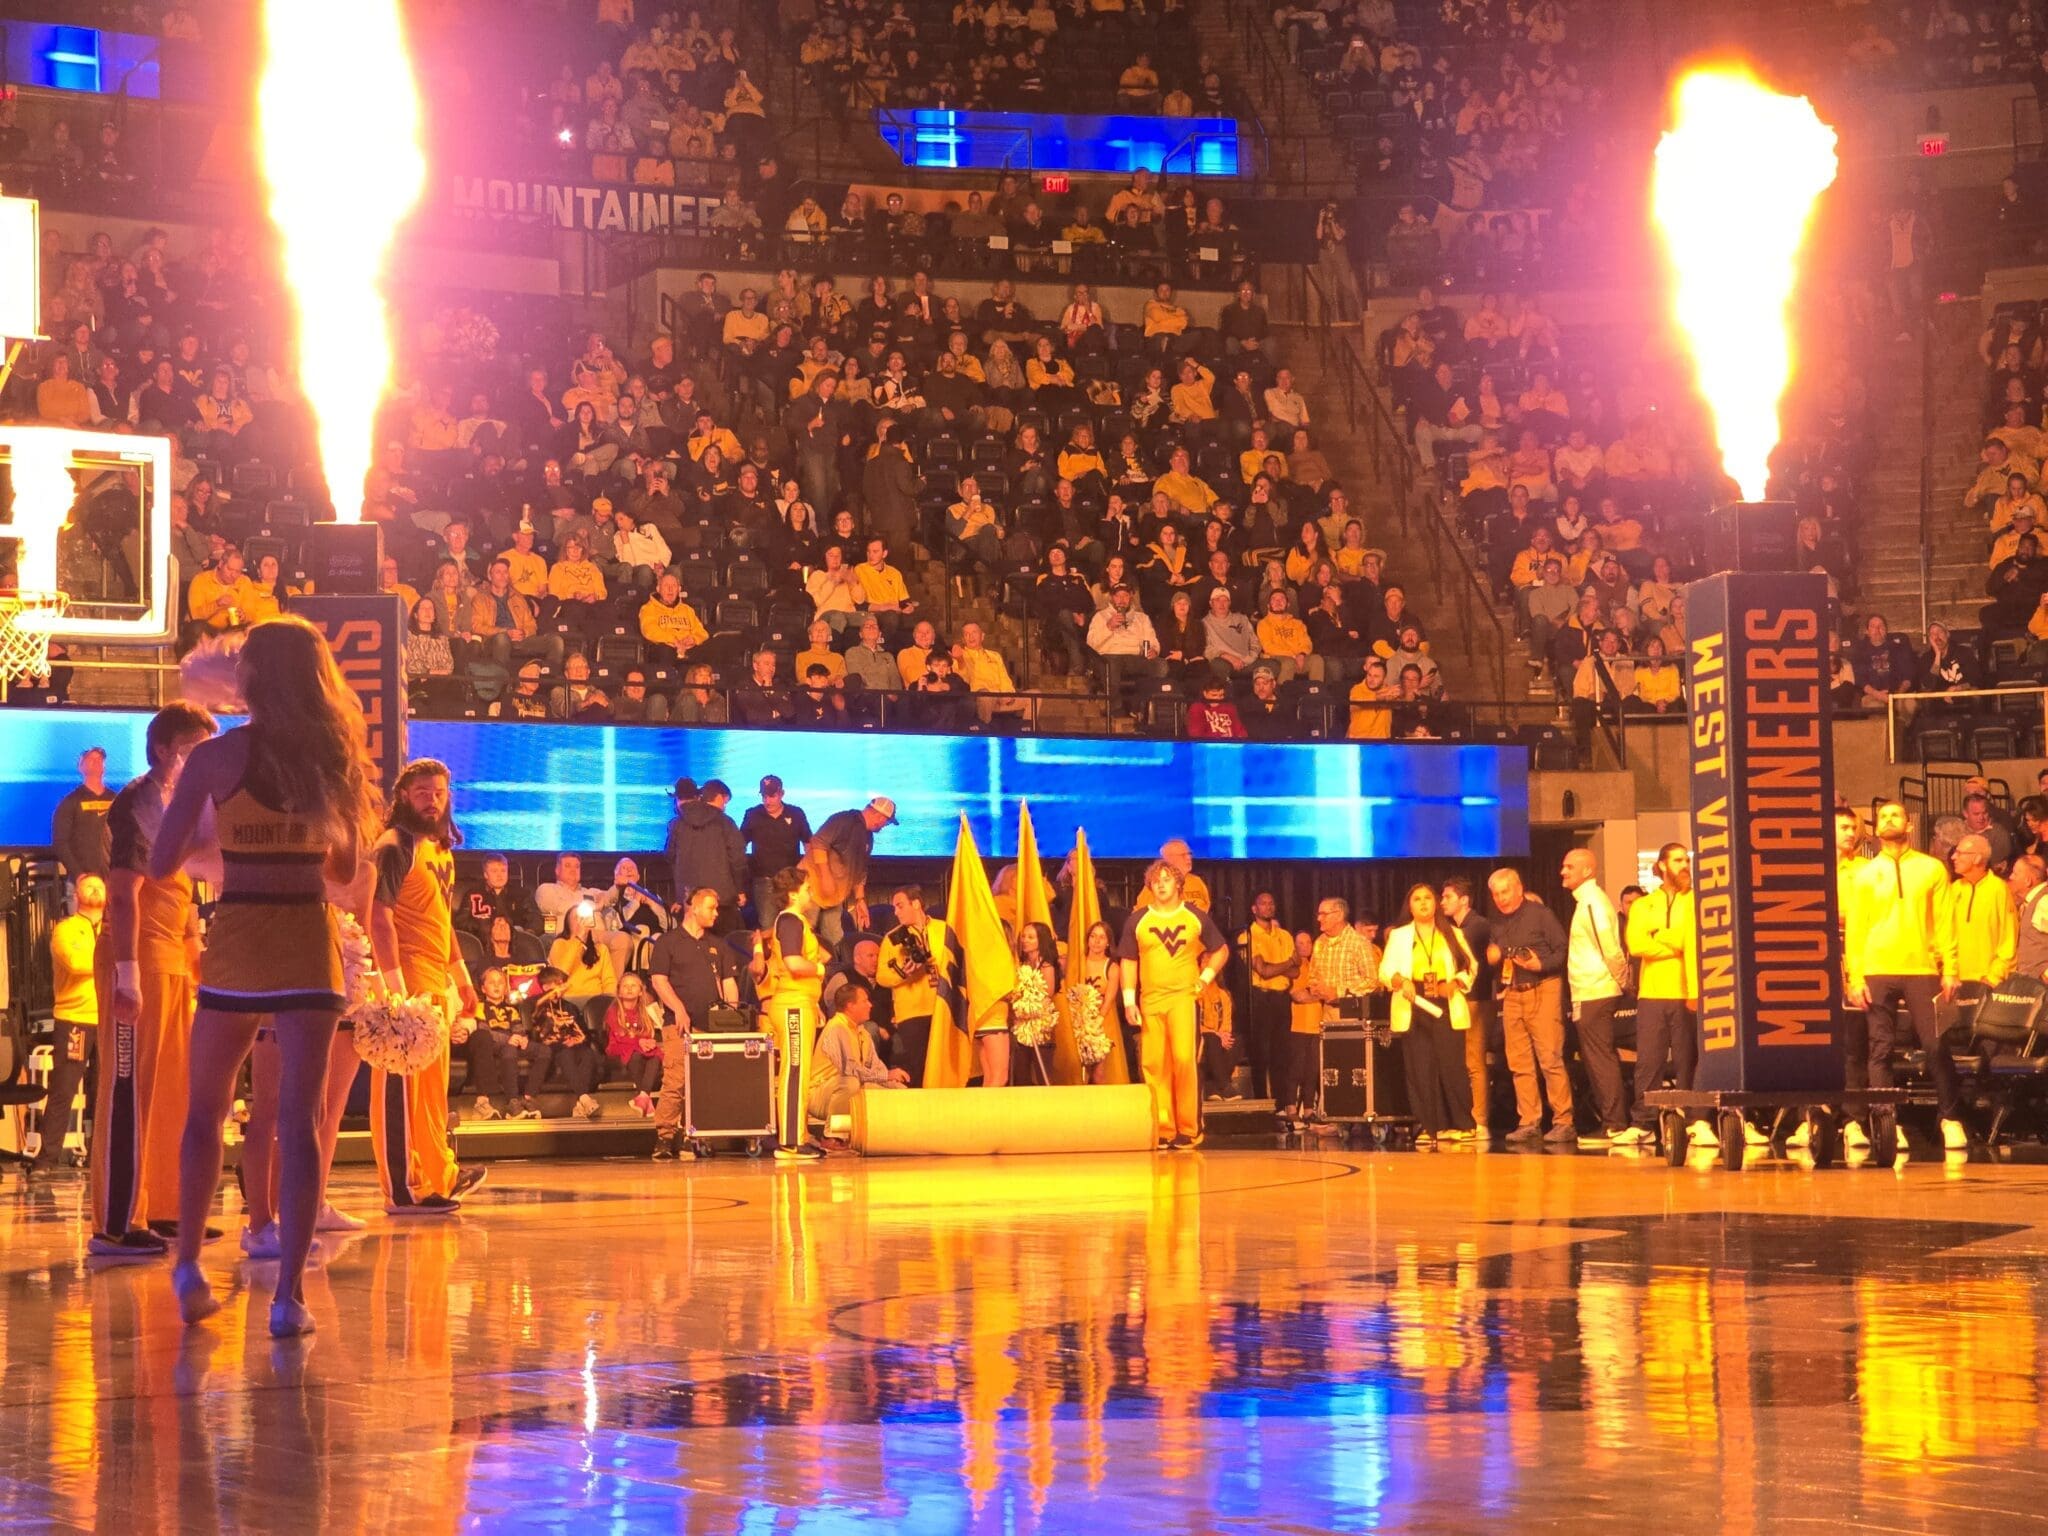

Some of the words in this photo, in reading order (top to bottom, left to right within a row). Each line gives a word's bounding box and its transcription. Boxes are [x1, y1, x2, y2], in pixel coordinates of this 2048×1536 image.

[1046, 177, 1065, 192] EXIT
[1923, 141, 1944, 155] EXIT
[1692, 632, 1727, 779] WEST
[1745, 609, 1832, 1046] MOUNTAINEERS
[1696, 796, 1736, 1051] VIRGINIA
[118, 1020, 132, 1078] IRGINIA
